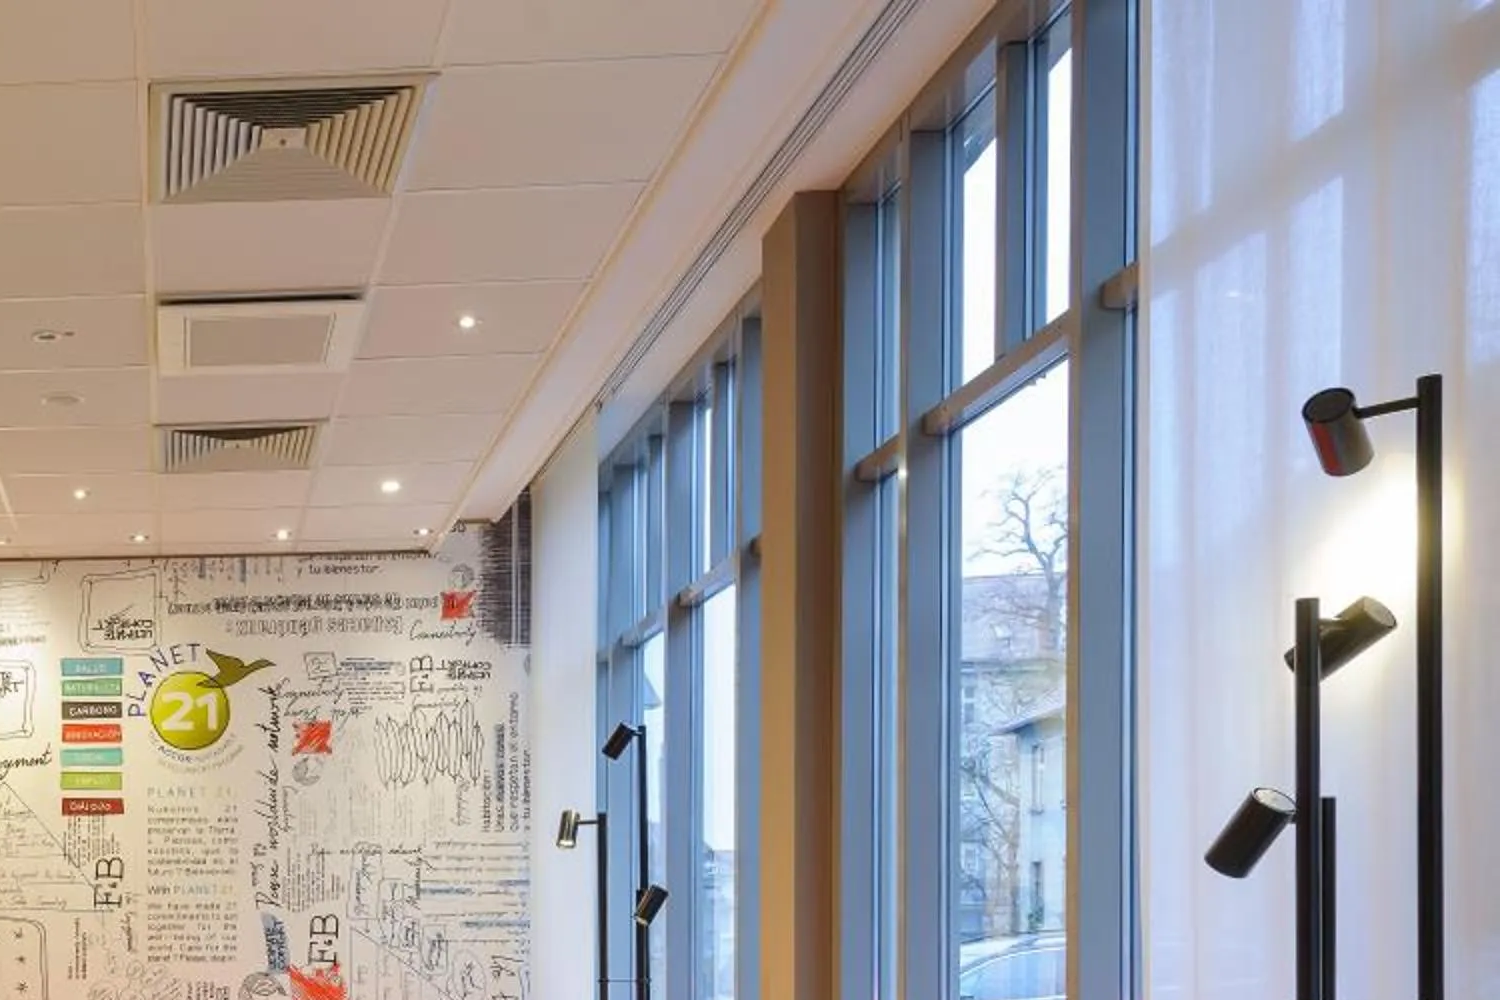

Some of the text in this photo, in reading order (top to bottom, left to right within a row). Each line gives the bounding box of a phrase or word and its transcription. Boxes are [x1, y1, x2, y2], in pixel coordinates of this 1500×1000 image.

[126, 643, 200, 717] PLANET
[161, 691, 219, 732] 21
[255, 681, 283, 754] network
[254, 759, 282, 850] worldwide
[306, 913, 339, 967] F&B
